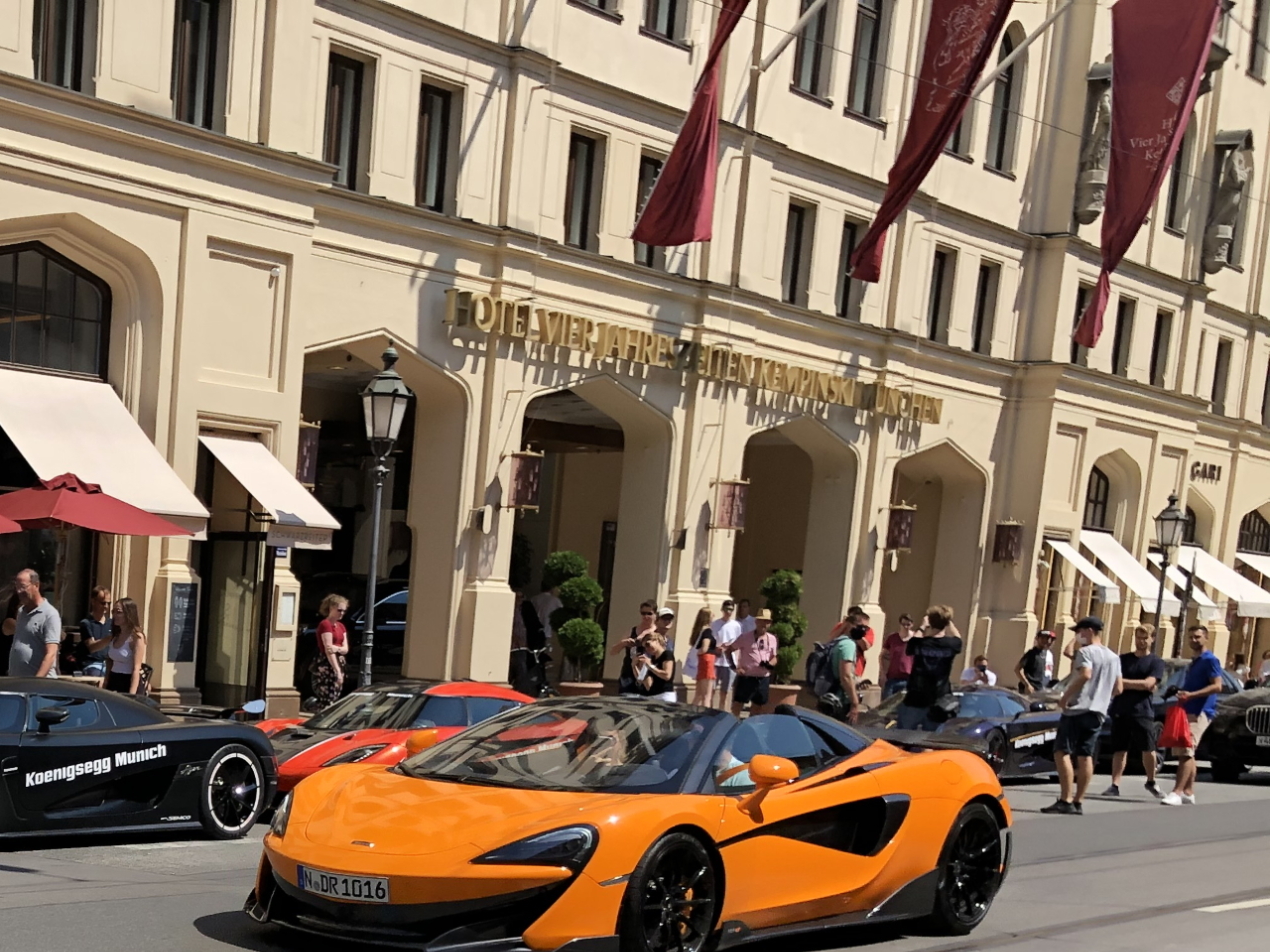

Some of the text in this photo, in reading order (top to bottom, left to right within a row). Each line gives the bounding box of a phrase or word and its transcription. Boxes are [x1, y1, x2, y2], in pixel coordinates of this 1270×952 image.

[442, 288, 541, 342] HOTEL
[535, 308, 596, 354] VIER
[756, 357, 856, 407] KEMPINSKI
[25, 743, 168, 788] Koenigsegg Munich
